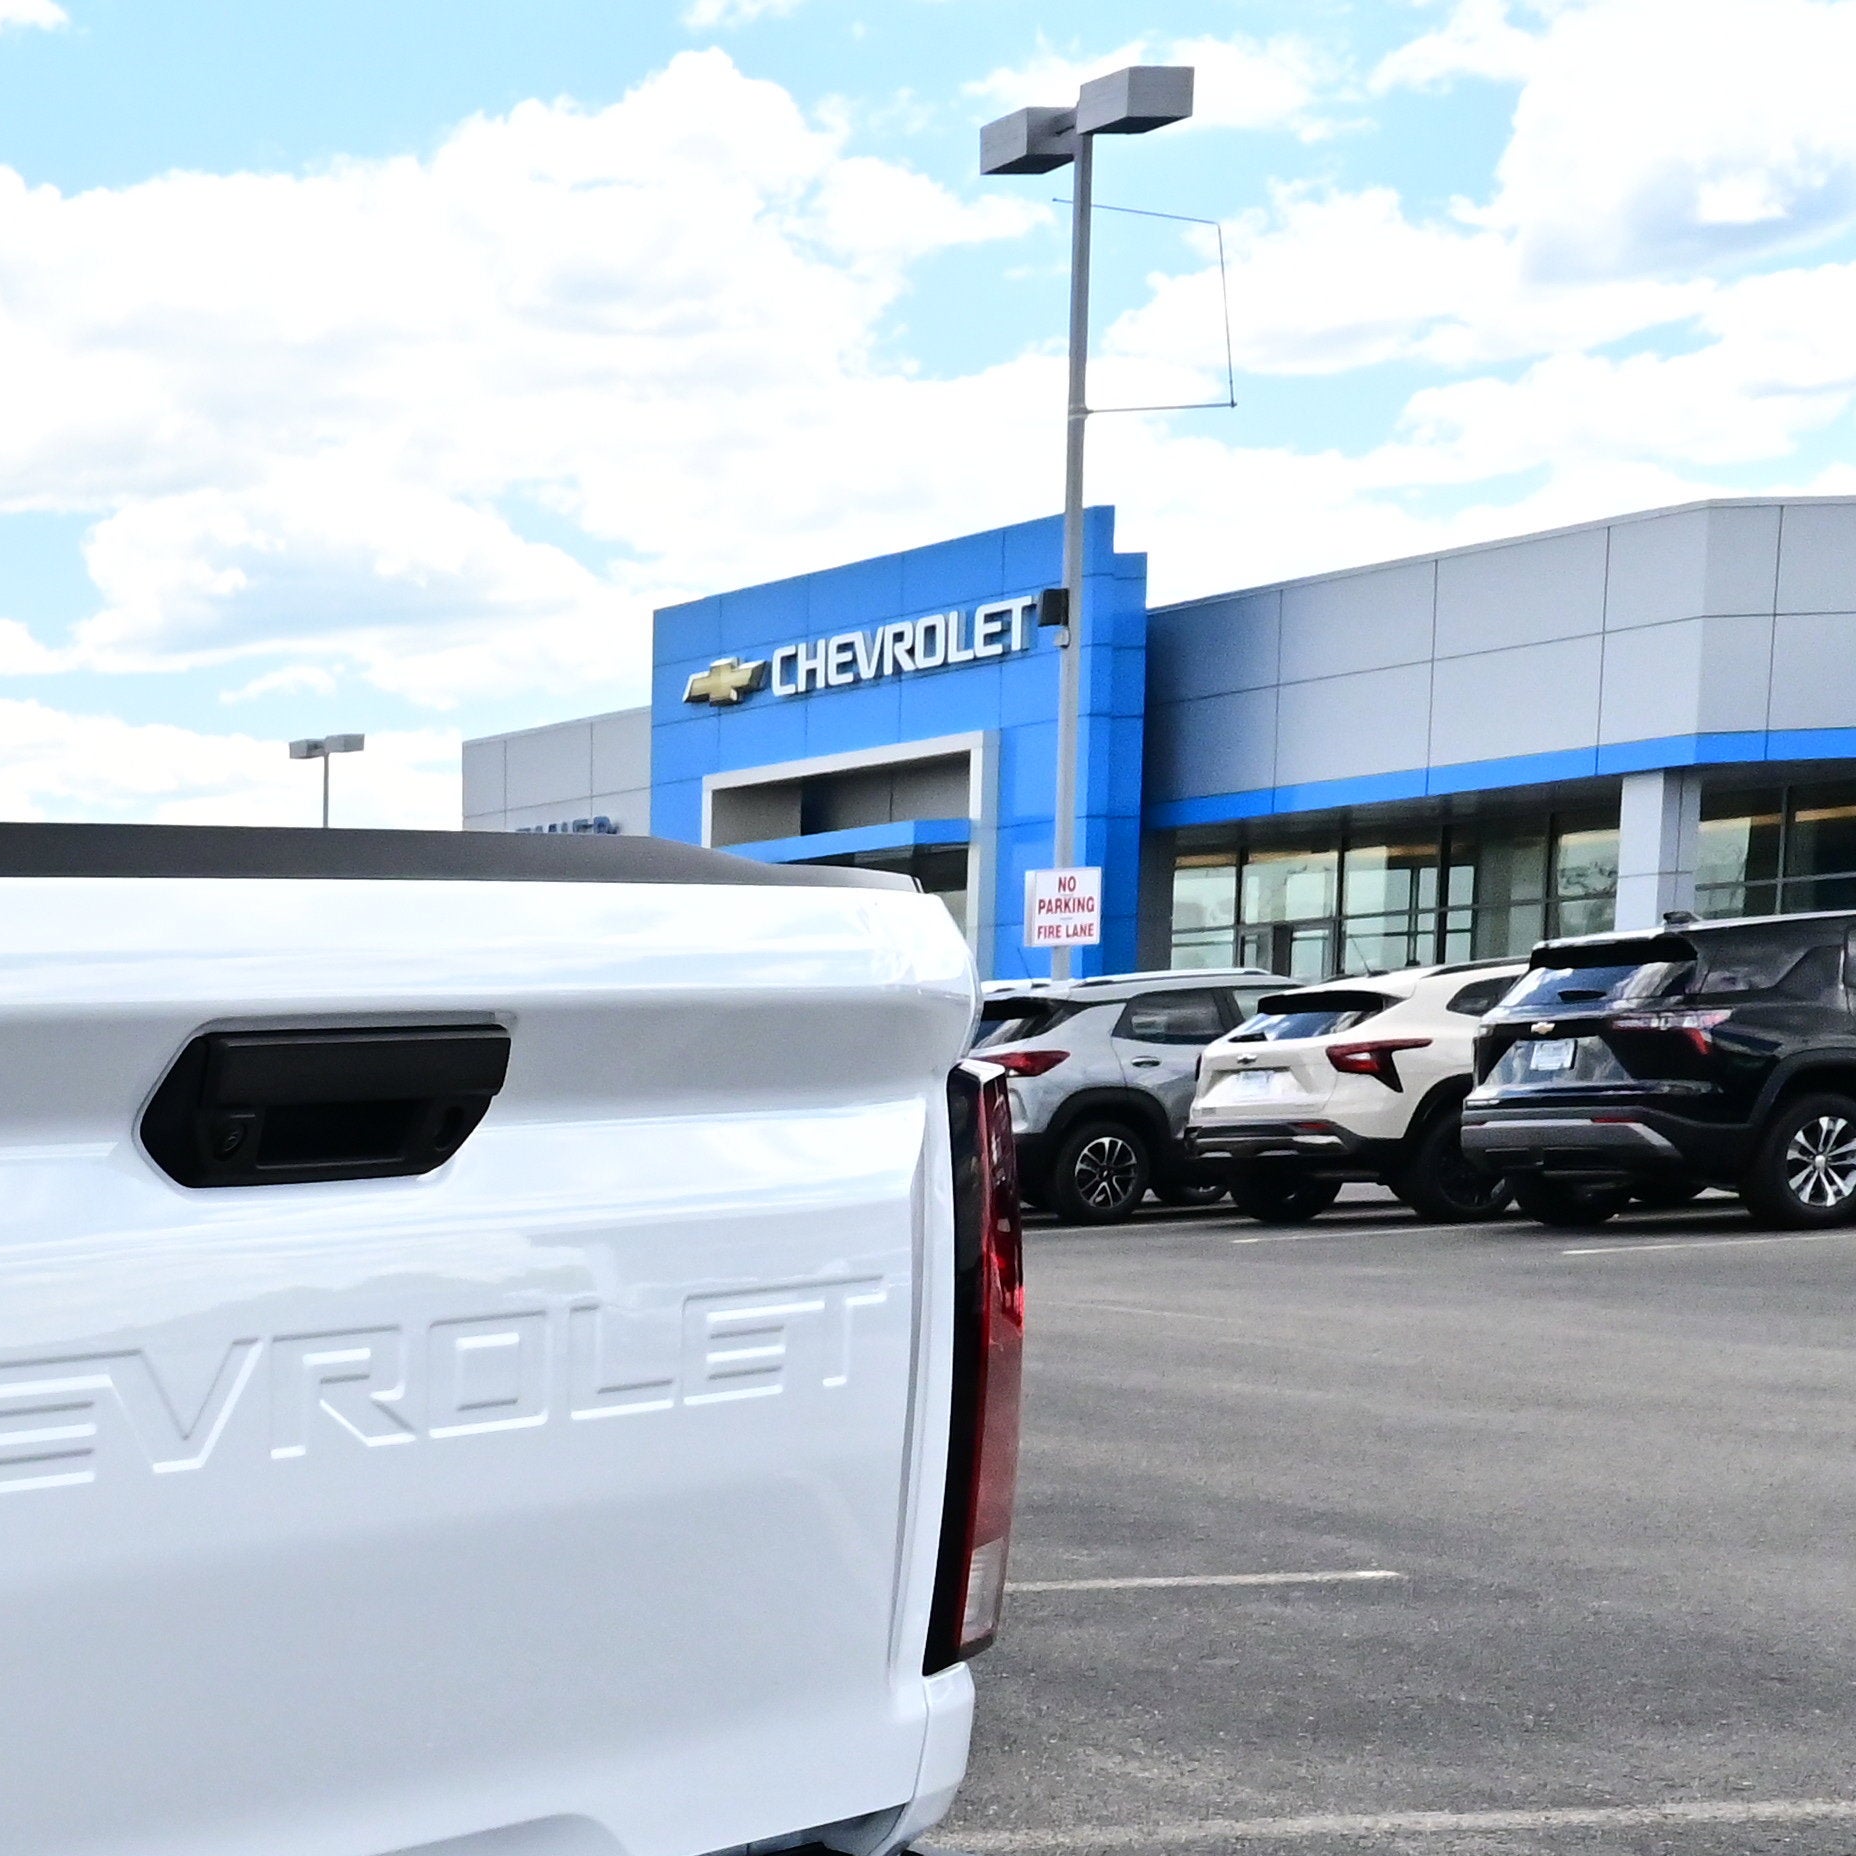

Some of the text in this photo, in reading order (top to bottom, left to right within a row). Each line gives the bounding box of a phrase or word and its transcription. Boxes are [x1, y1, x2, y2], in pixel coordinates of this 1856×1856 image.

[771, 595, 1035, 698] CHEVROLET
[1057, 875, 1077, 893] NO
[1037, 896, 1095, 916] PARKING
[1037, 922, 1094, 940] FIRE LANE
